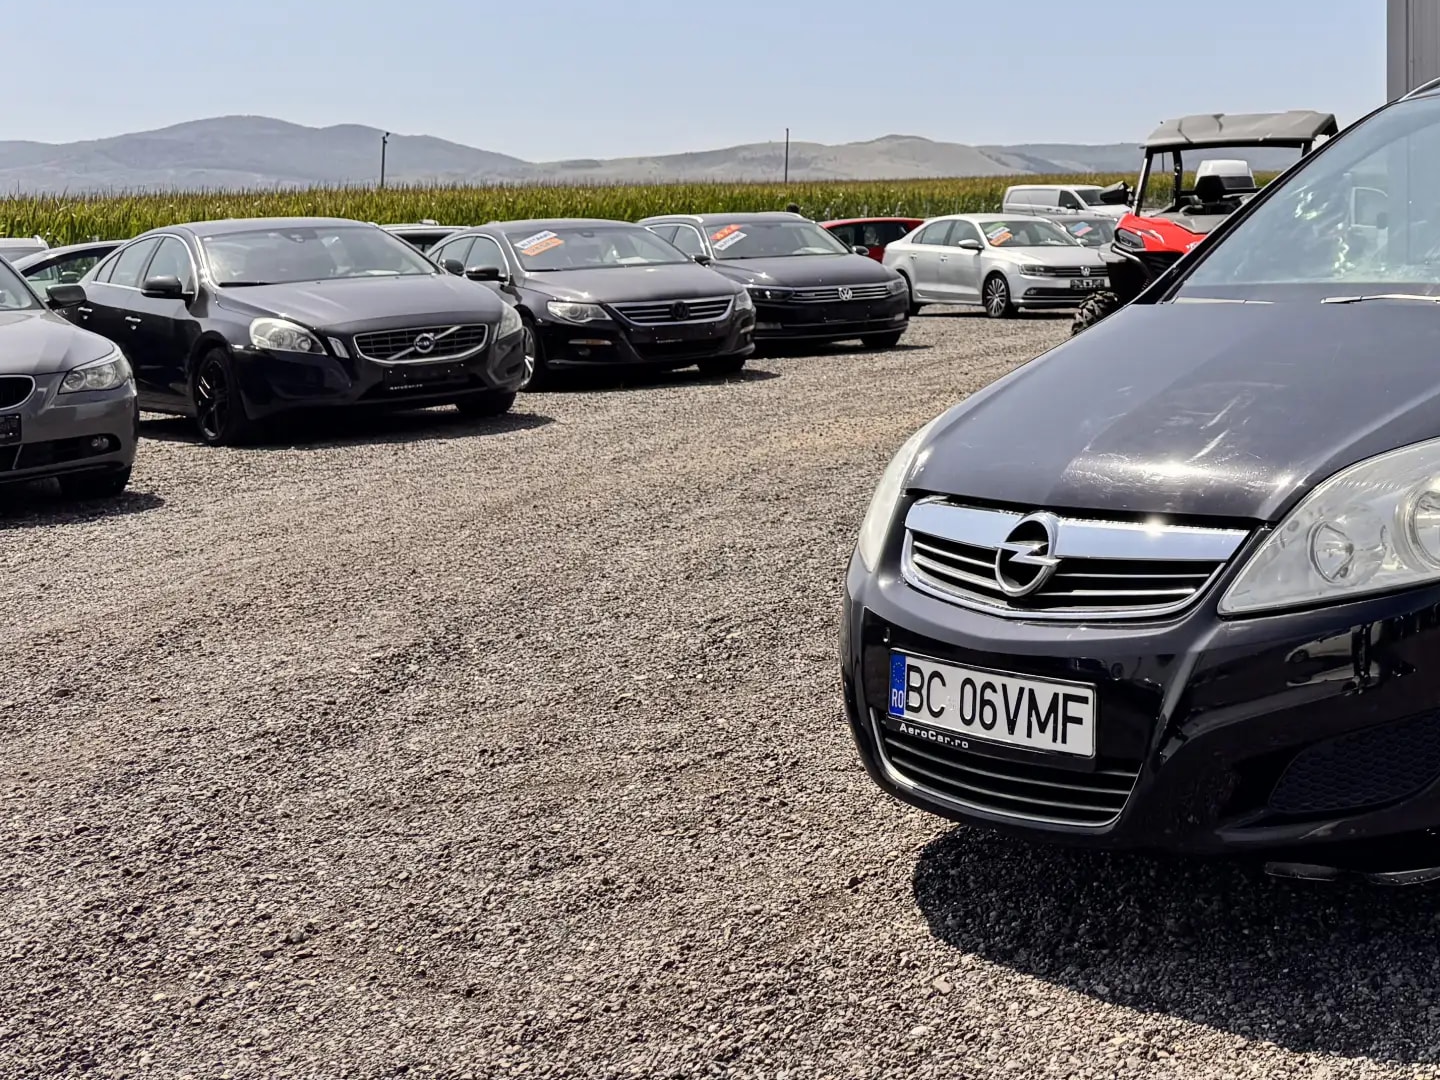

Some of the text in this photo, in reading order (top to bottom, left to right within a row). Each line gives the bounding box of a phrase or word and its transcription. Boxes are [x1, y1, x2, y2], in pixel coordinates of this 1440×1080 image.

[891, 688, 904, 708] RO
[905, 663, 1089, 745] BC 06VMF
[899, 722, 969, 749] AeroCar.ro
